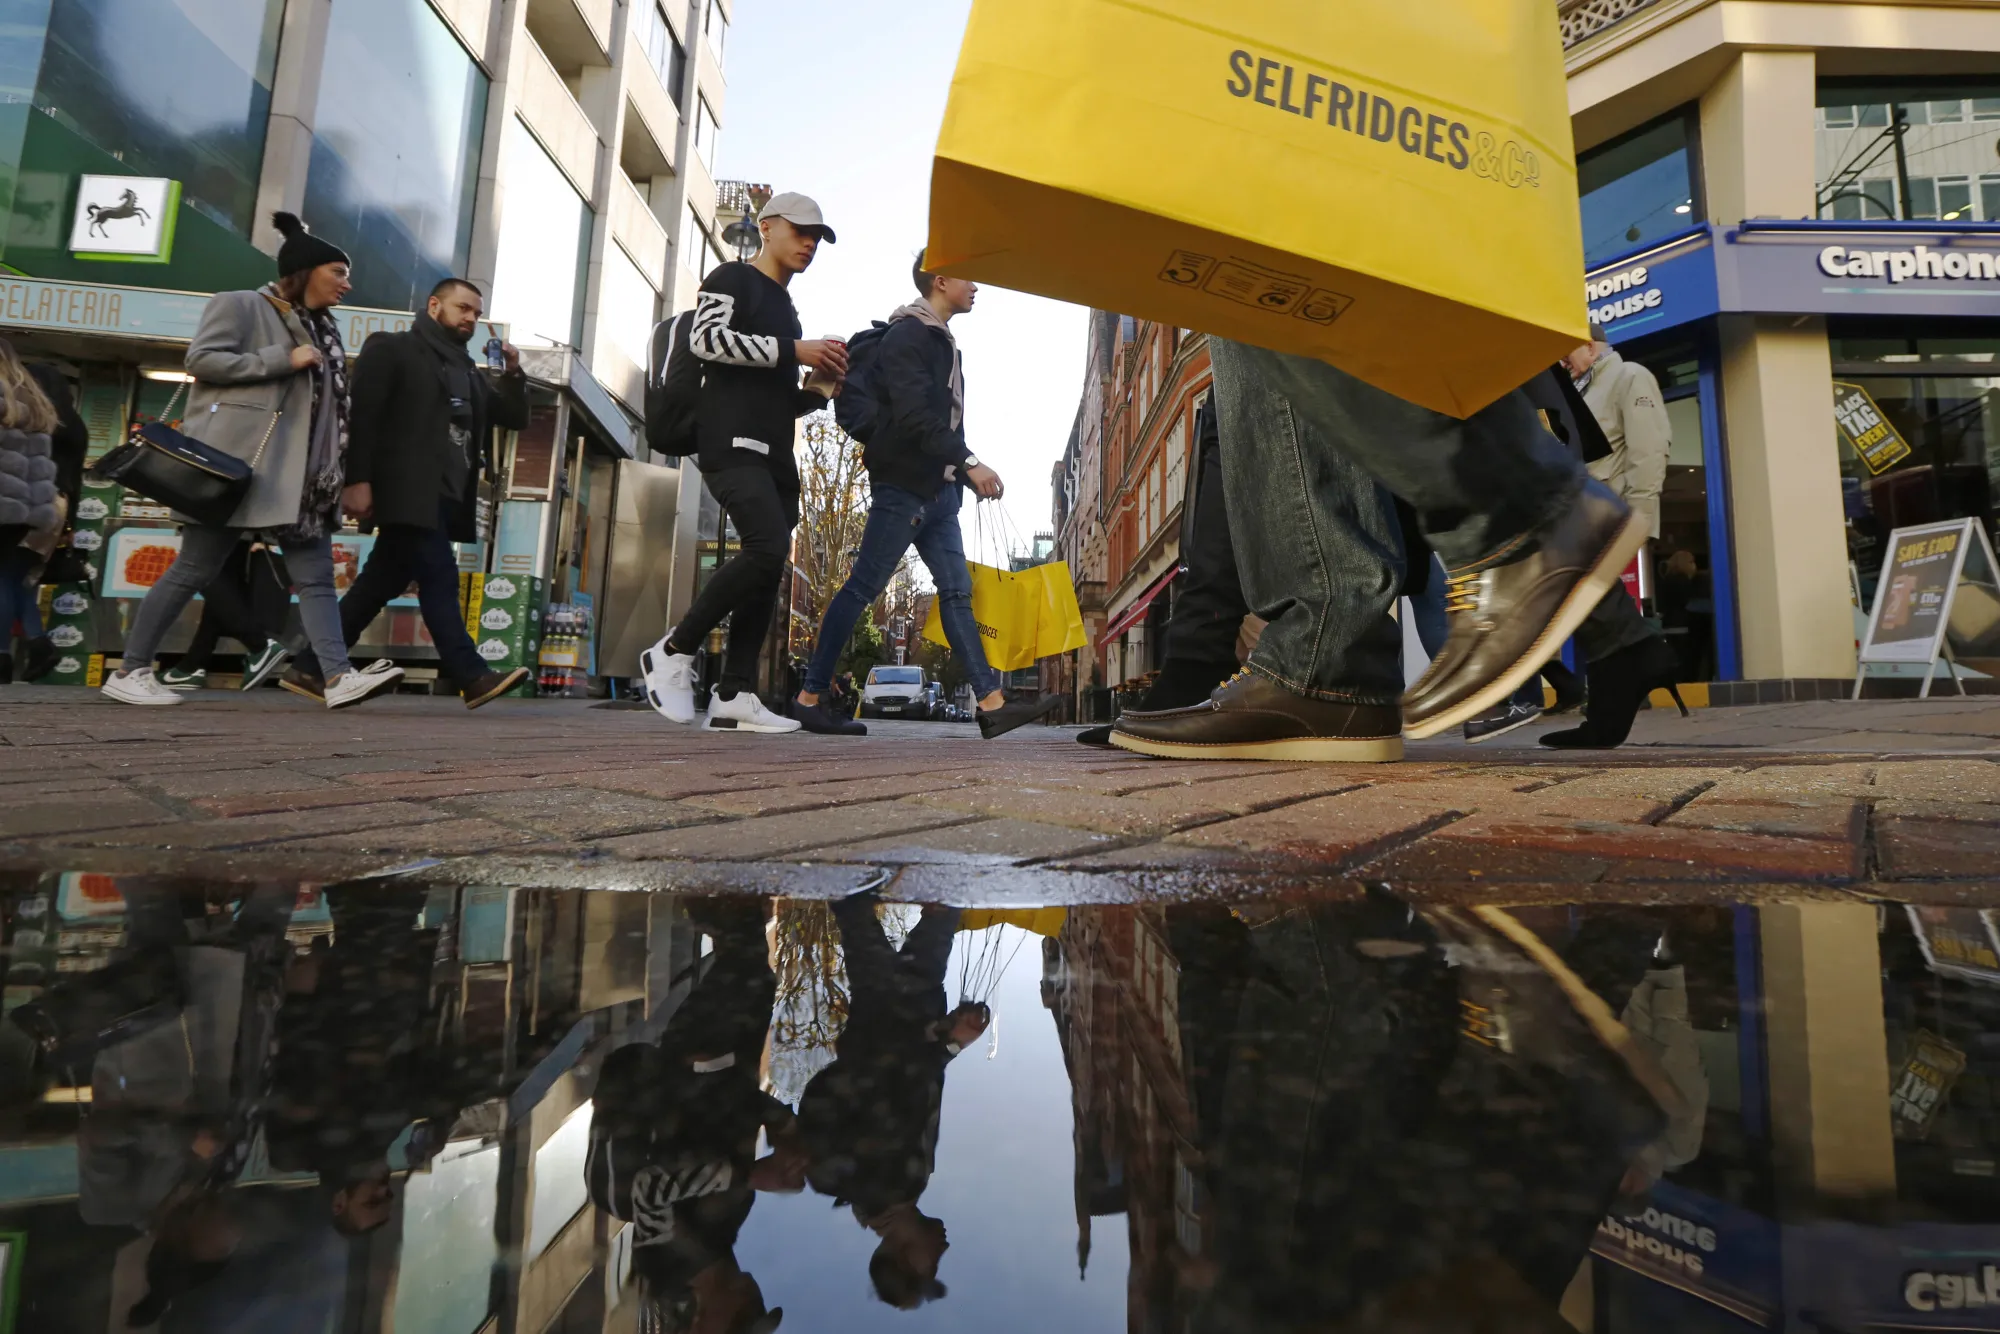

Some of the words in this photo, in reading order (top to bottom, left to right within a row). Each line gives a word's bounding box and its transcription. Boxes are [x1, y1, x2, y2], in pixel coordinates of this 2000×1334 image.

[1820, 246, 2000, 282] Carphon
[1840, 405, 1880, 437] TAG
[1856, 422, 1888, 450] EVENT
[1898, 541, 1928, 563] SAVE
[976, 621, 998, 639] RIDGES
